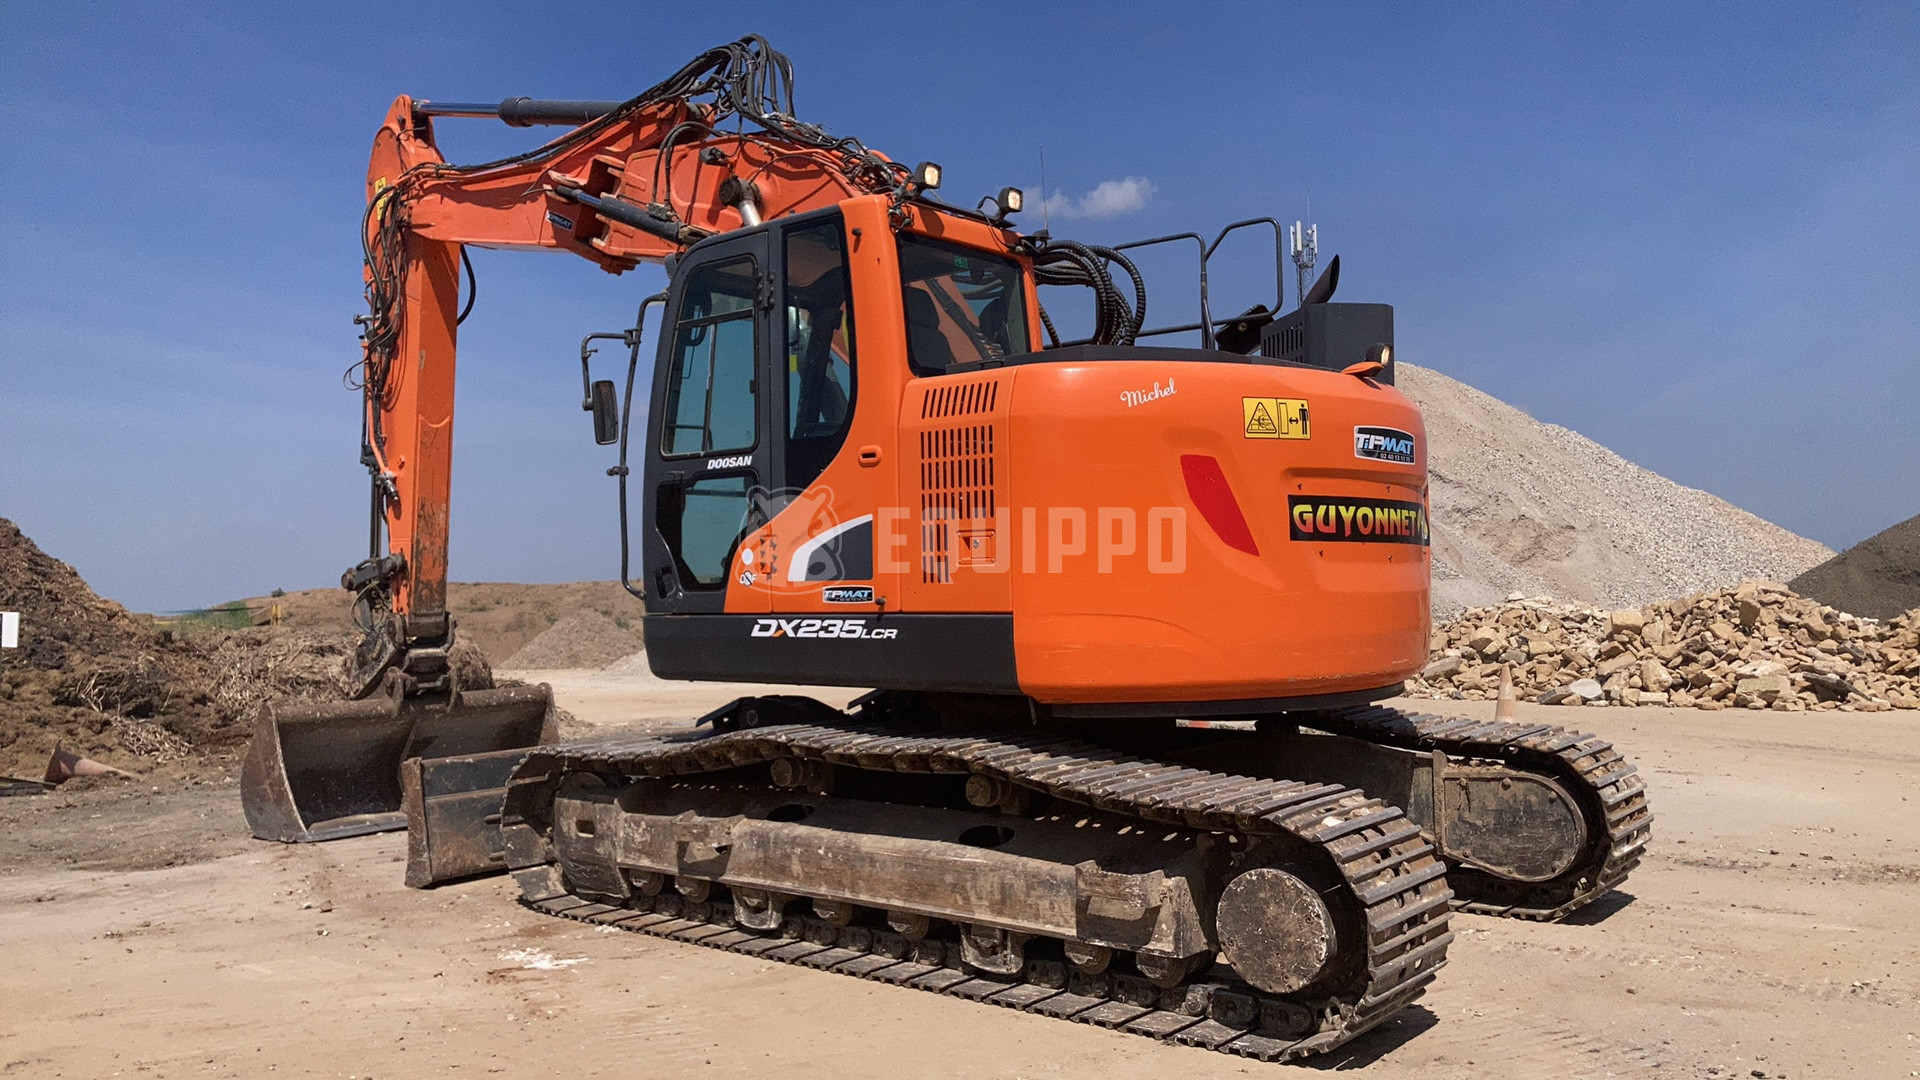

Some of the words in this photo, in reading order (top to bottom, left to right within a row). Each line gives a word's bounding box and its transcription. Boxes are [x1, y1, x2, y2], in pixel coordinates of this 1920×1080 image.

[1120, 377, 1177, 408] Michel
[707, 455, 752, 470] DOOSAN
[1293, 504, 1417, 537] GUYONNET
